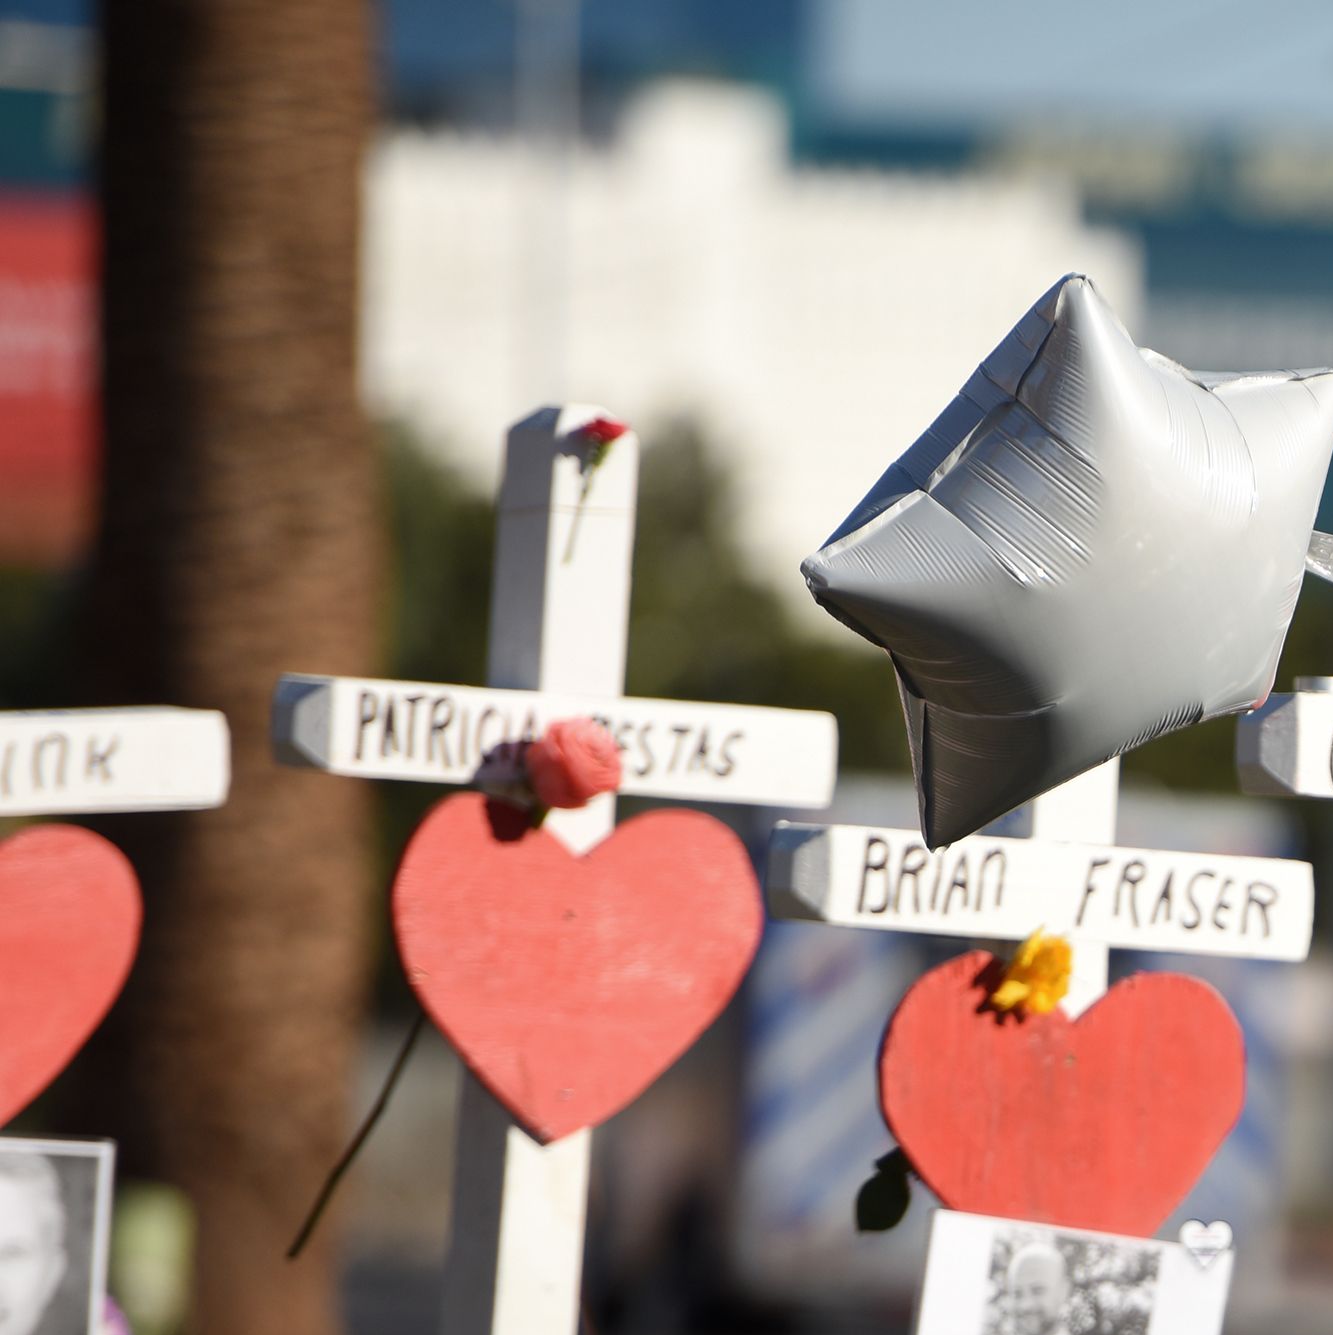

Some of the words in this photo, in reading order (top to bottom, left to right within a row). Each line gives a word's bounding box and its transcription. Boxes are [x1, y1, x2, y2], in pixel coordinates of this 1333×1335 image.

[590, 713, 745, 778] ESTAS
[857, 837, 1008, 916] BRIAN
[1075, 858, 1280, 940] FRASER
